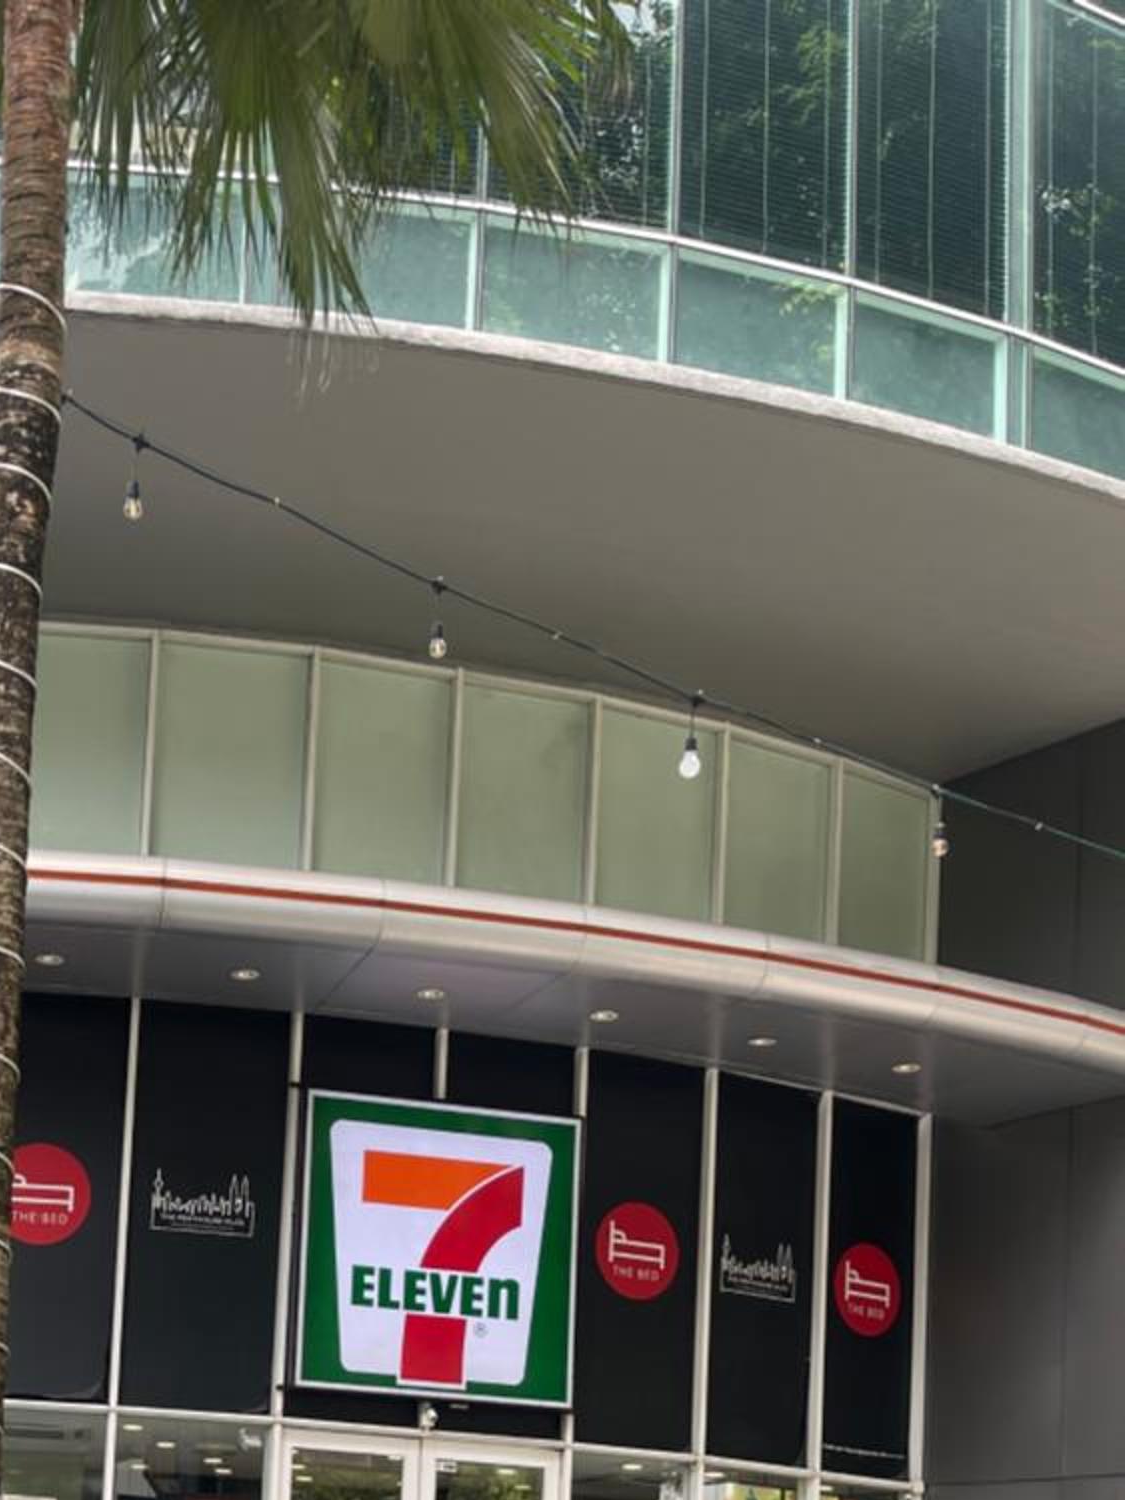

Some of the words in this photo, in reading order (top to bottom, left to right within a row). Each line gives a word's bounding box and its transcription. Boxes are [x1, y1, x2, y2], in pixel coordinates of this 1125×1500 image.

[41, 1211, 69, 1226] BED
[362, 1149, 525, 1386] 7
[613, 1264, 634, 1279] THE
[637, 1268, 660, 1282] BED
